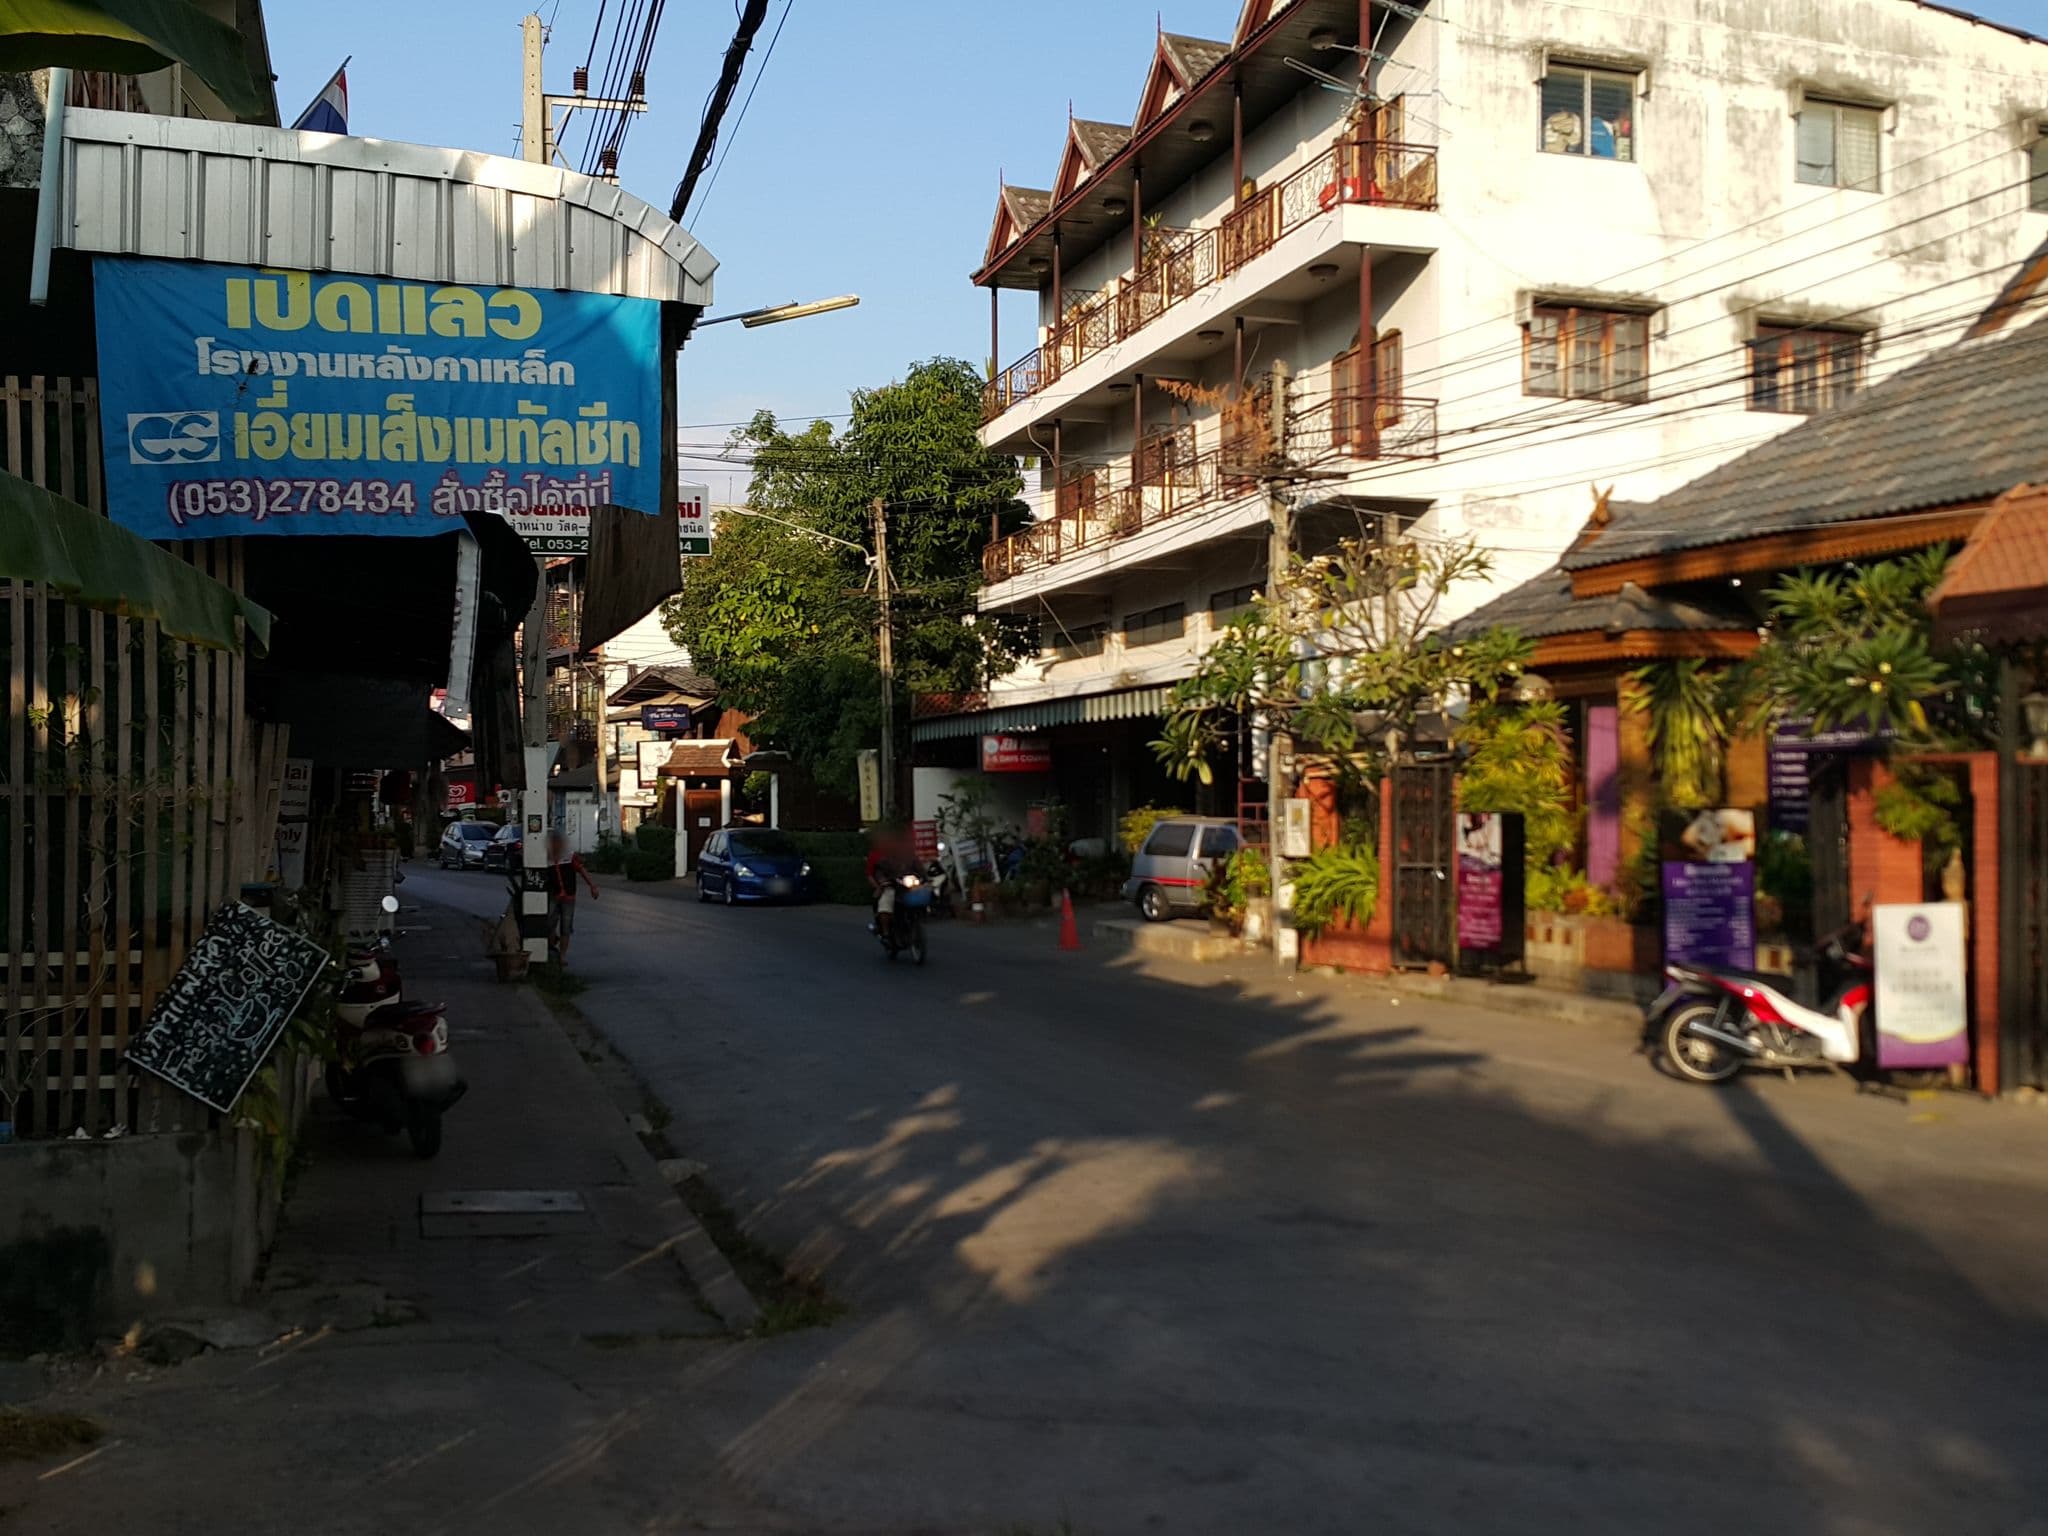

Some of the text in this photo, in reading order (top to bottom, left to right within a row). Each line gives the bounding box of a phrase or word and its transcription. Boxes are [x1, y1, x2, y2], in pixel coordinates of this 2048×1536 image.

[194, 337, 575, 386] โรงงานหลังคาเหล็ก
[234, 380, 640, 467] เอี่ยมเส็งเมทัลชีท
[170, 479, 414, 524] (053)278434
[680, 522, 704, 533] ชนิด
[160, 929, 288, 1088] Fresh Coffee
